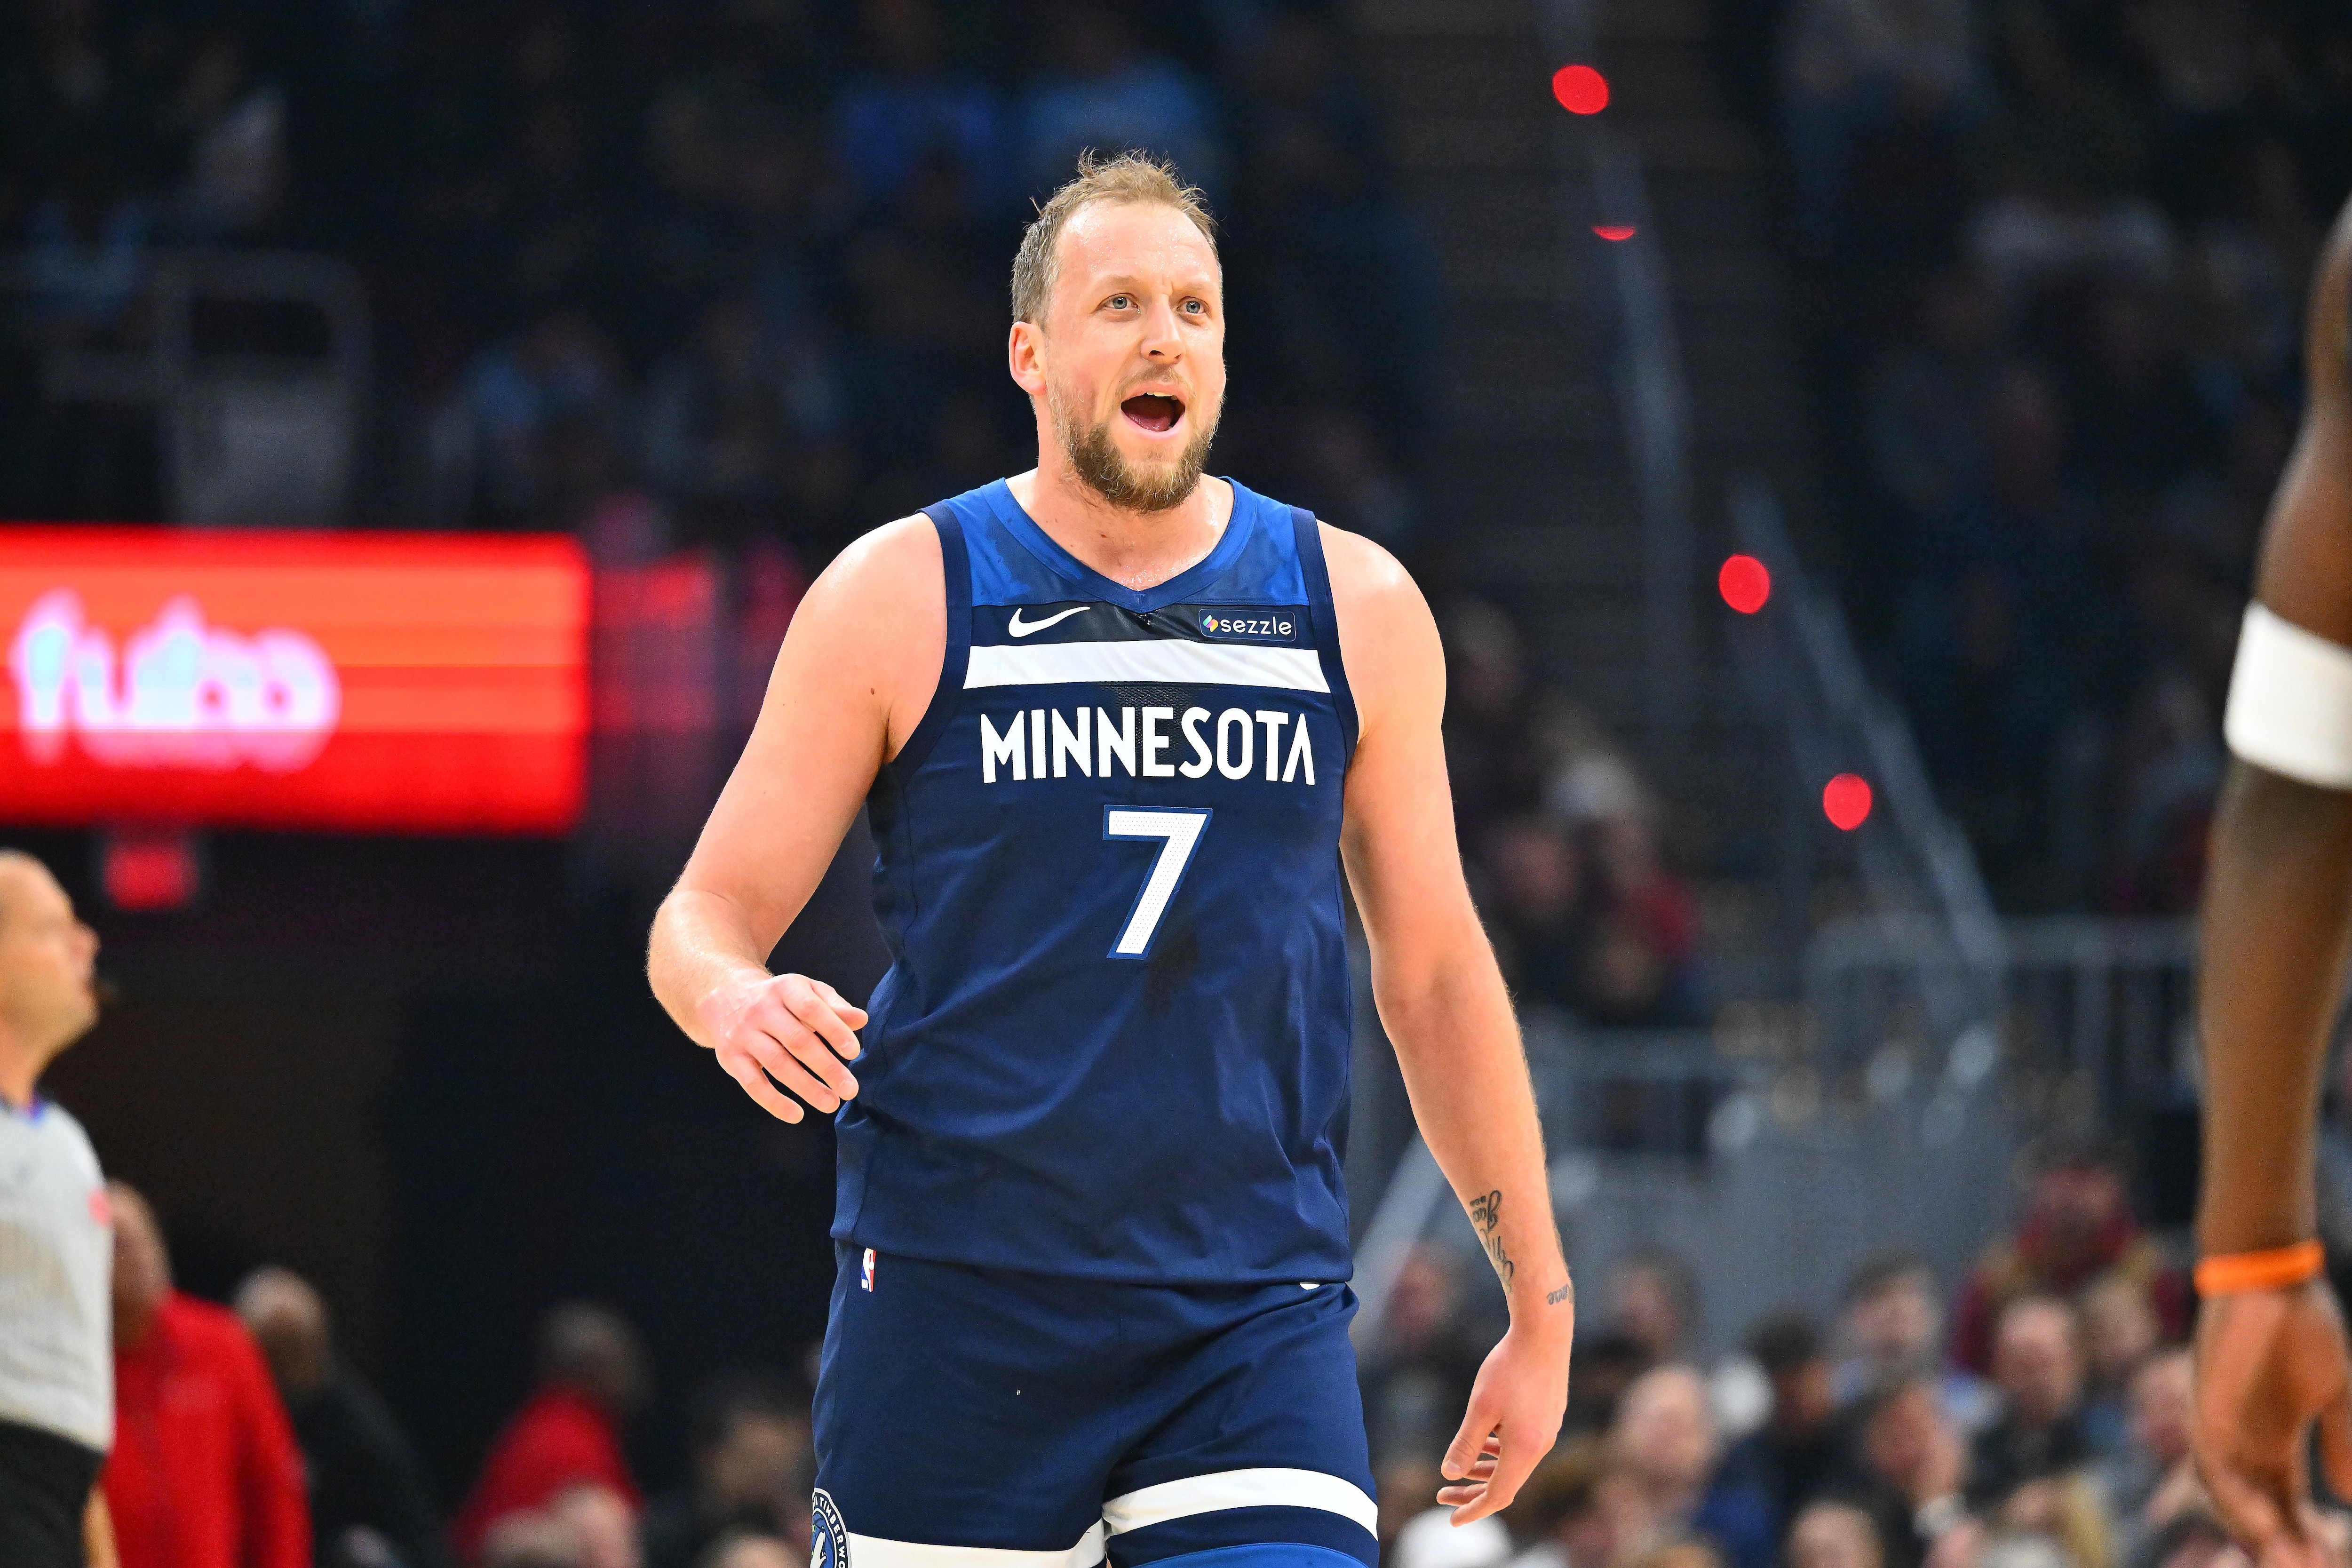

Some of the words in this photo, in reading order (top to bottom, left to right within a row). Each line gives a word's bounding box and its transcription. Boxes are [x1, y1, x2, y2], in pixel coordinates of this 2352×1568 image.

[1220, 616, 1292, 635] sezzle
[981, 706, 1315, 786] MINNESOTA
[1104, 805, 1212, 959] 7
